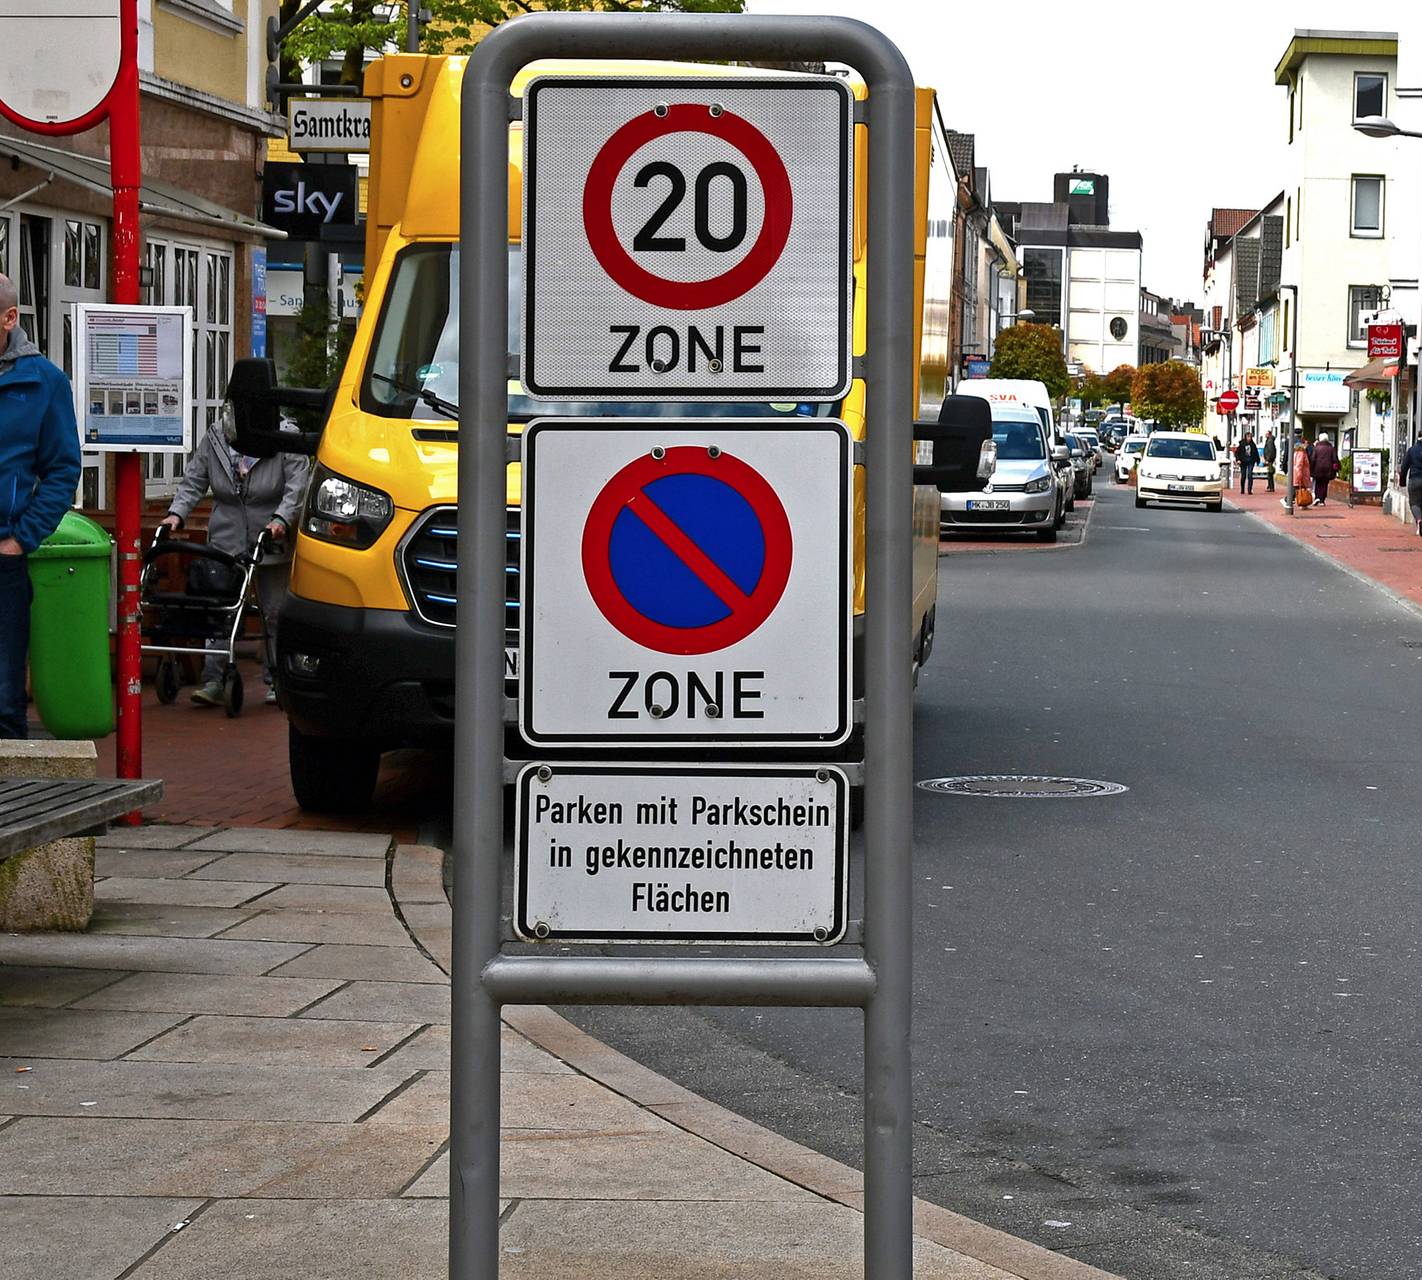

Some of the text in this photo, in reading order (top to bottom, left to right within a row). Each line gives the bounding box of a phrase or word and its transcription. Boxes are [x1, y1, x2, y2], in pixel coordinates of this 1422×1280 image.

[273, 180, 345, 224] sky
[633, 160, 748, 253] 20
[608, 325, 764, 373] ZONE
[608, 671, 764, 719] ZONE
[535, 794, 830, 827] Parken mit Parkschein
[550, 838, 814, 876] in gekennzeichneten
[632, 882, 730, 913] Flächen
